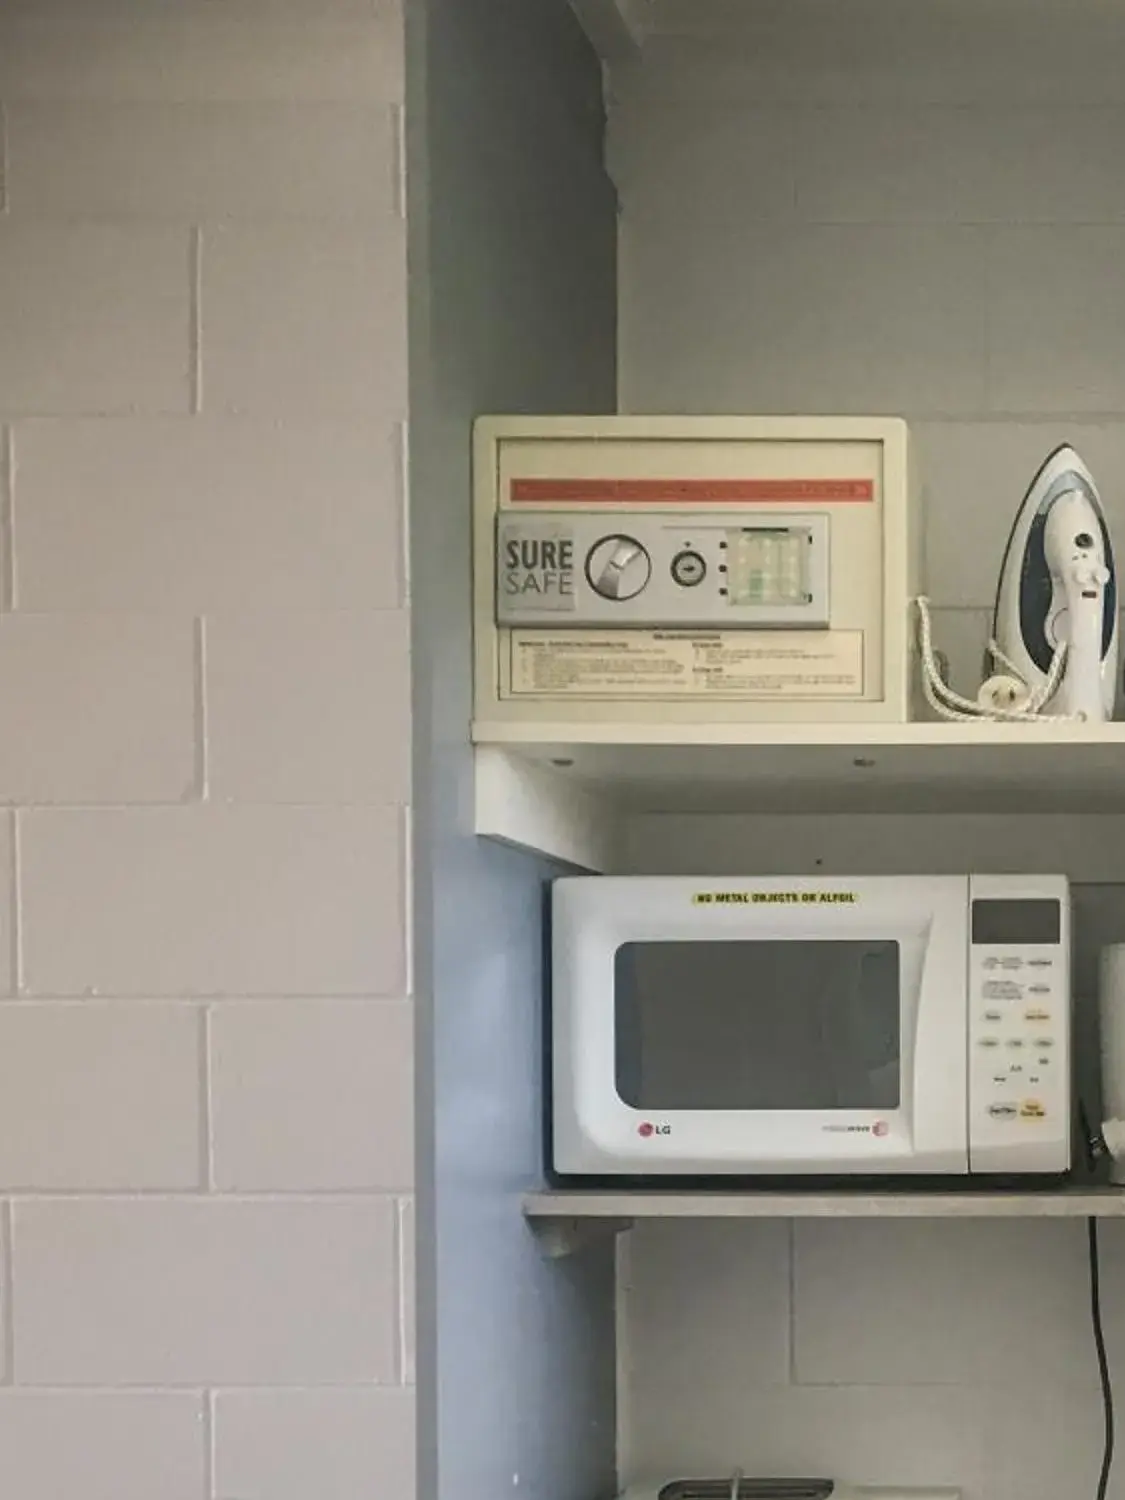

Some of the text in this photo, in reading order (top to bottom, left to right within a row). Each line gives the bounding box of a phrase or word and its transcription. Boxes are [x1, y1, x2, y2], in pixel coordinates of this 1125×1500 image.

[505, 539, 573, 571] SURE
[505, 573, 573, 596] SAFE
[697, 893, 712, 903] NO
[715, 893, 749, 903] METAL
[752, 893, 799, 903] OBJECTS
[801, 893, 817, 903] OR
[655, 1125, 671, 1135] LG
